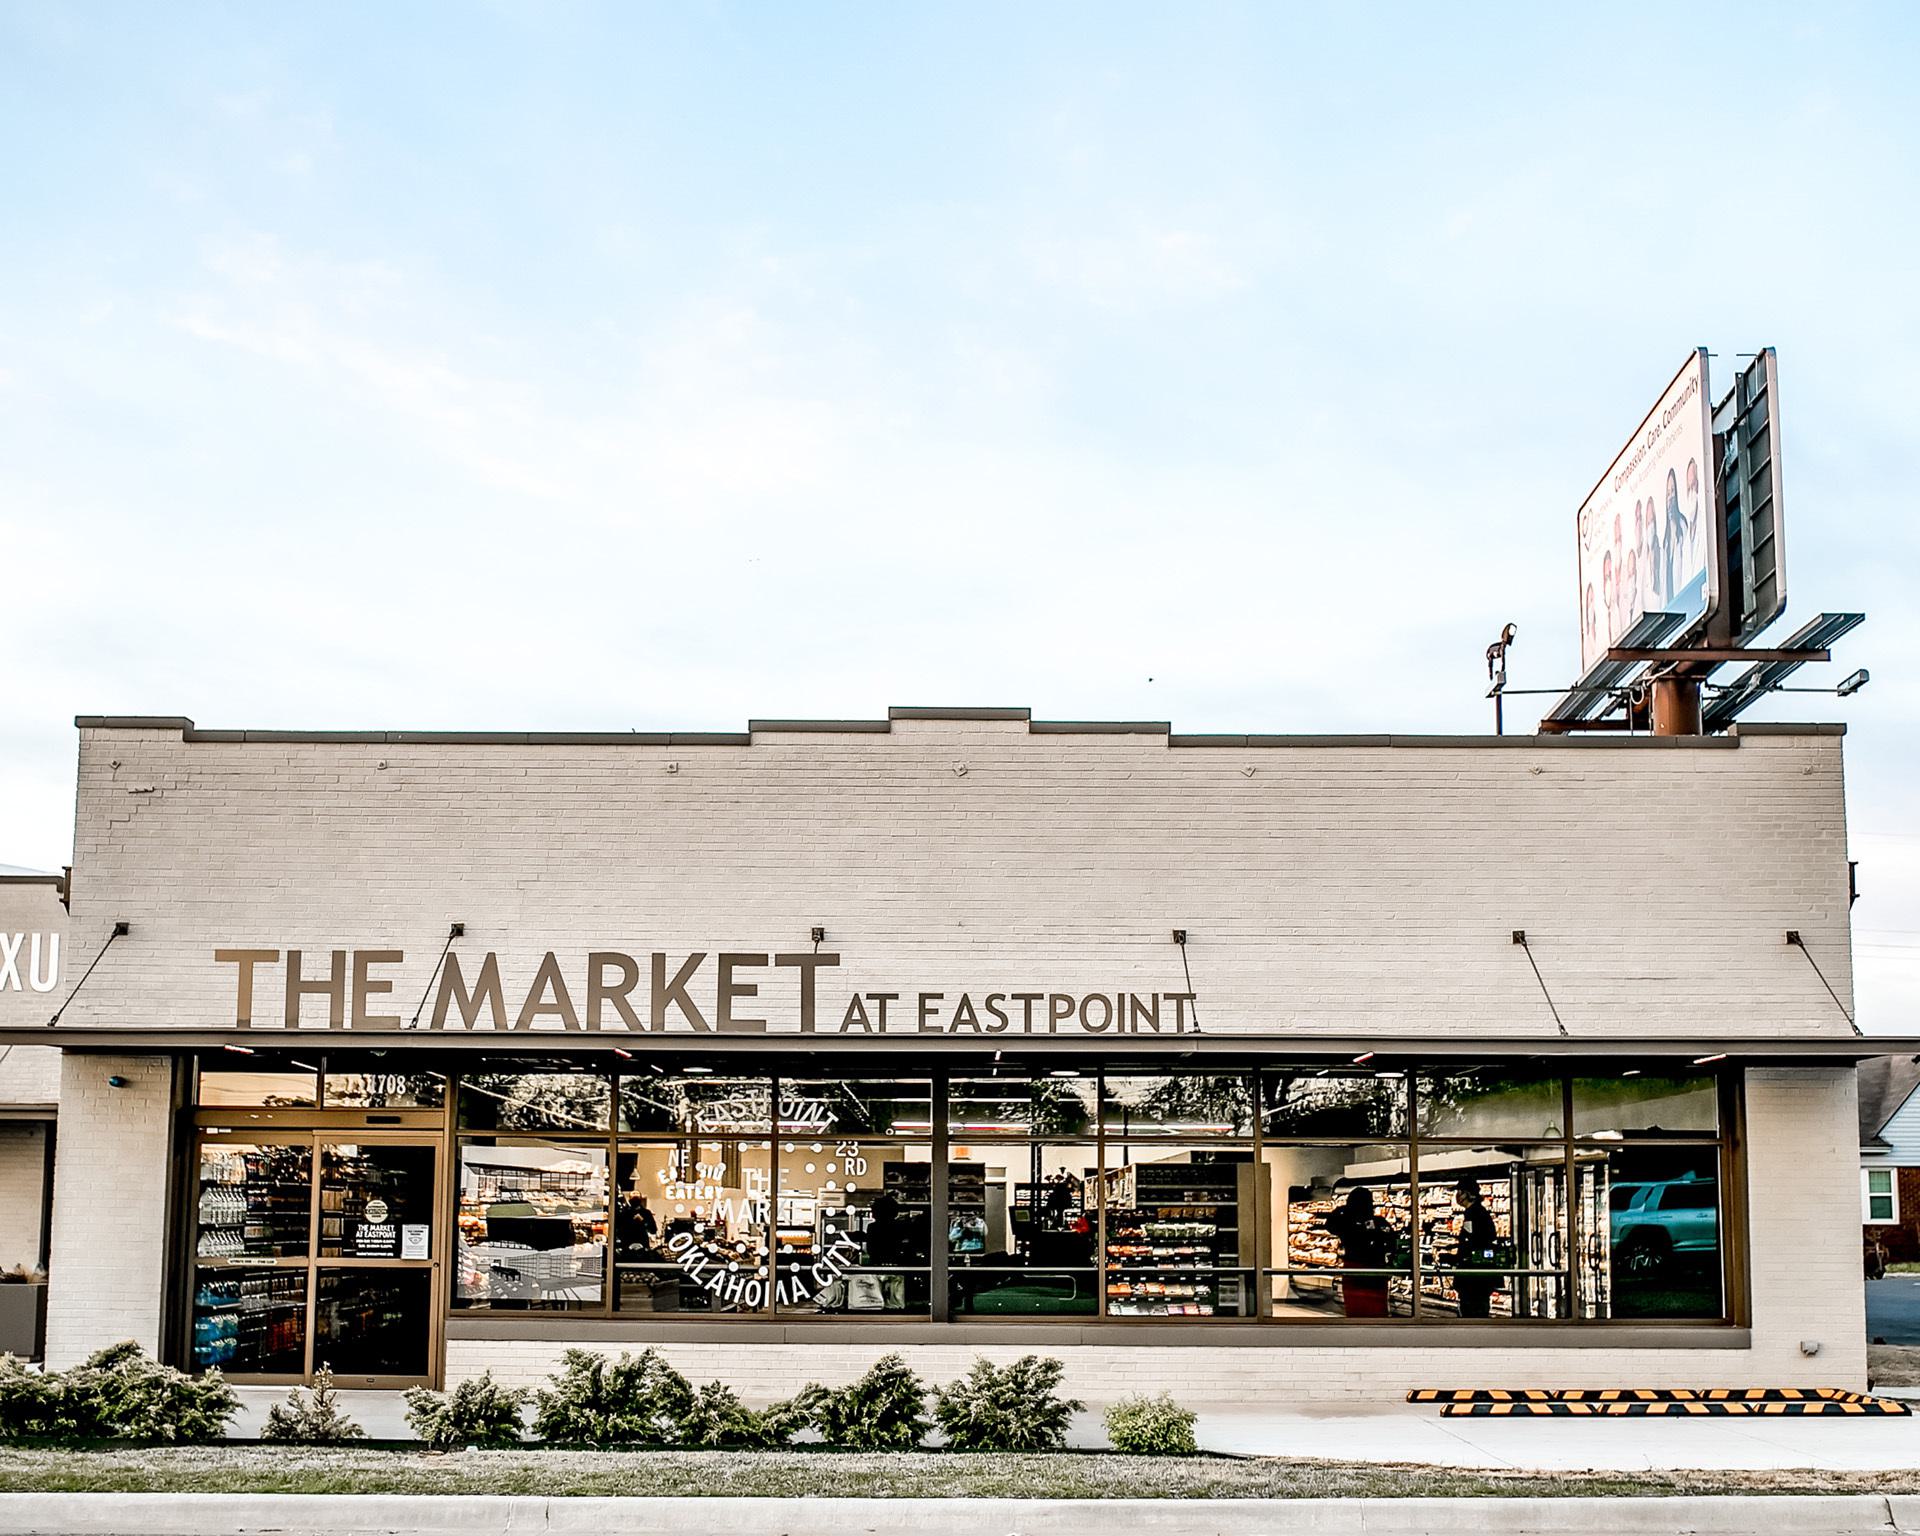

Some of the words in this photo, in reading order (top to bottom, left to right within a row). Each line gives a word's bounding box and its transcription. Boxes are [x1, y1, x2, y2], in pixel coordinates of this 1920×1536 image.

[1662, 374, 1699, 429] Community
[214, 949, 404, 1030] THE
[430, 951, 841, 1032] MARKET
[839, 992, 899, 1033] AT
[918, 992, 1197, 1034] EASTPOINT
[668, 1148, 691, 1167] NE
[835, 1140, 859, 1158] 23
[845, 1157, 867, 1176] RD
[711, 1198, 802, 1225] MARK
[668, 1232, 811, 1308] OKLAHOMA
[811, 1230, 861, 1288] CITY
